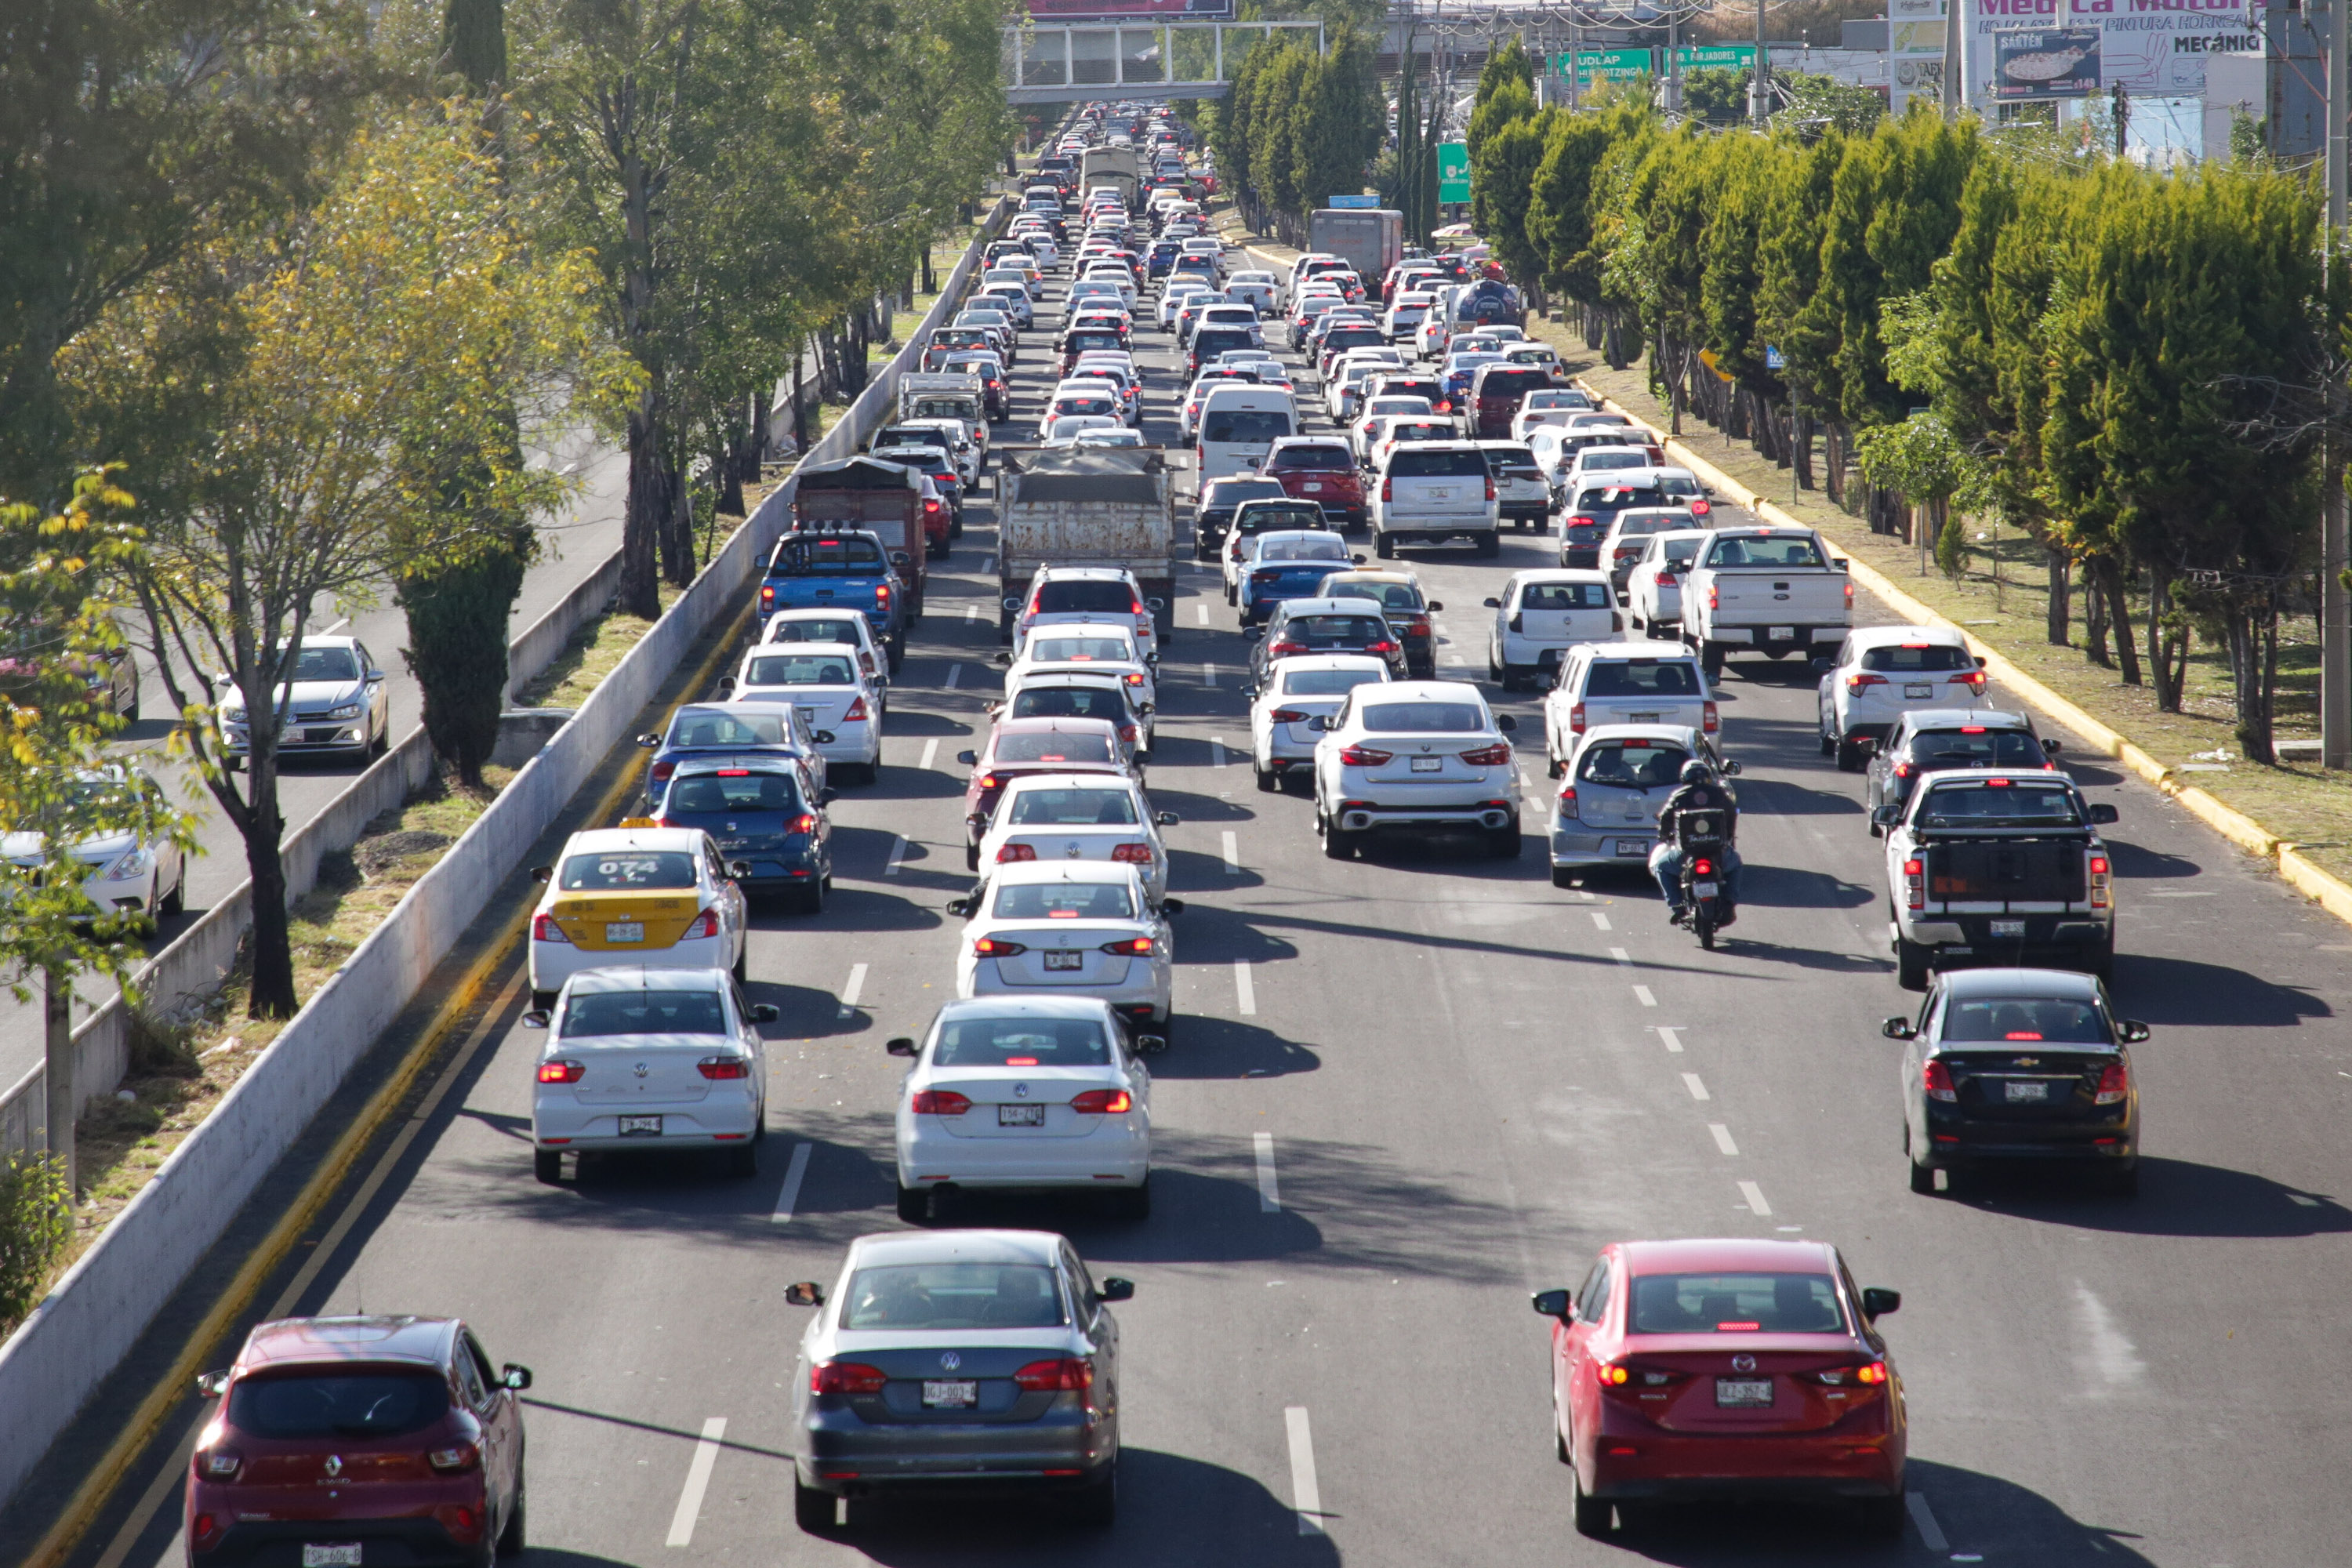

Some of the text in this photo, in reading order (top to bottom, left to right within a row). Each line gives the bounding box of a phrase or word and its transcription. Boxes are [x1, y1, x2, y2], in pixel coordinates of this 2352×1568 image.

[2105, 16, 2175, 31] PINTURA
[2179, 13, 2267, 29] HORNEAA
[2001, 34, 2043, 49] SARTÉN
[1578, 56, 1621, 65] UDLAP
[598, 861, 658, 876] 074
[306, 1548, 361, 1563] TSH-606-B
